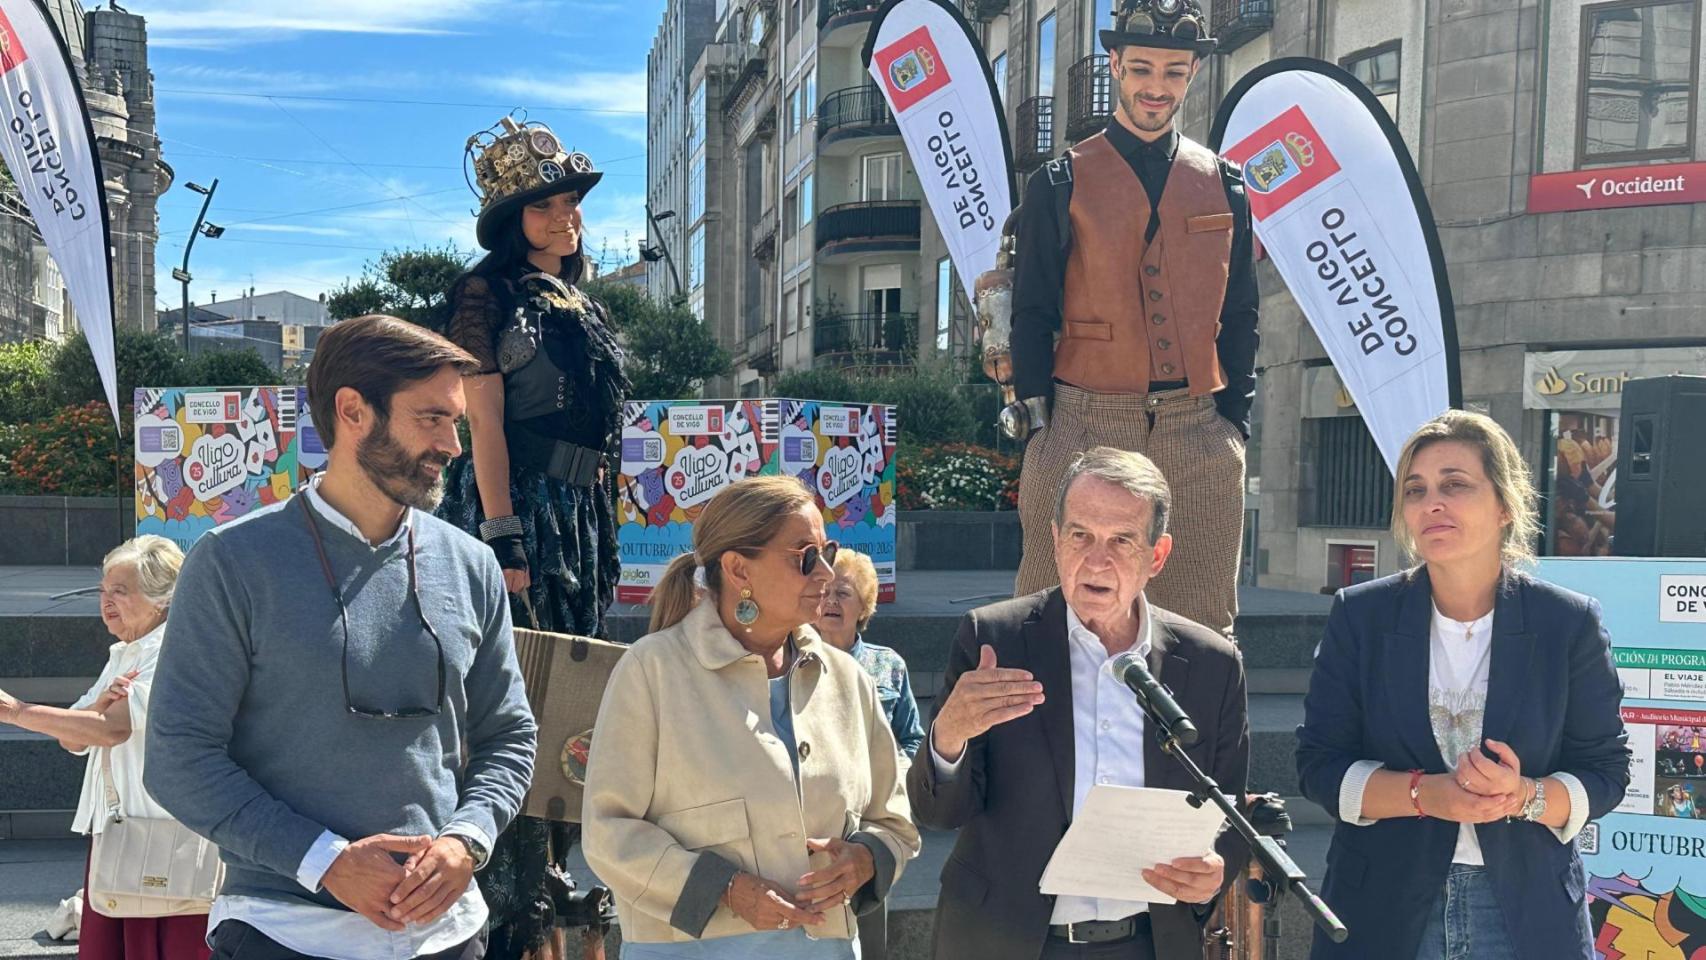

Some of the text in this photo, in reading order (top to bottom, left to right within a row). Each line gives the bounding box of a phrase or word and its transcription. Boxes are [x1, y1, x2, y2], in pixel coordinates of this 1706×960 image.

[1601, 175, 1685, 196] Occident
[1571, 371, 1631, 393] Sant
[189, 400, 220, 408] CONCELLO
[672, 413, 704, 421] CONCELLO
[198, 442, 238, 468] Vigo
[681, 453, 721, 478] Vigo
[829, 453, 859, 478] Vigo
[198, 464, 242, 493] cultura
[679, 473, 723, 501] cultura
[828, 474, 860, 501] cultura
[622, 543, 674, 557] OUTUBRO
[1677, 601, 1697, 612] DE
[1611, 830, 1706, 858] OUTUBR
